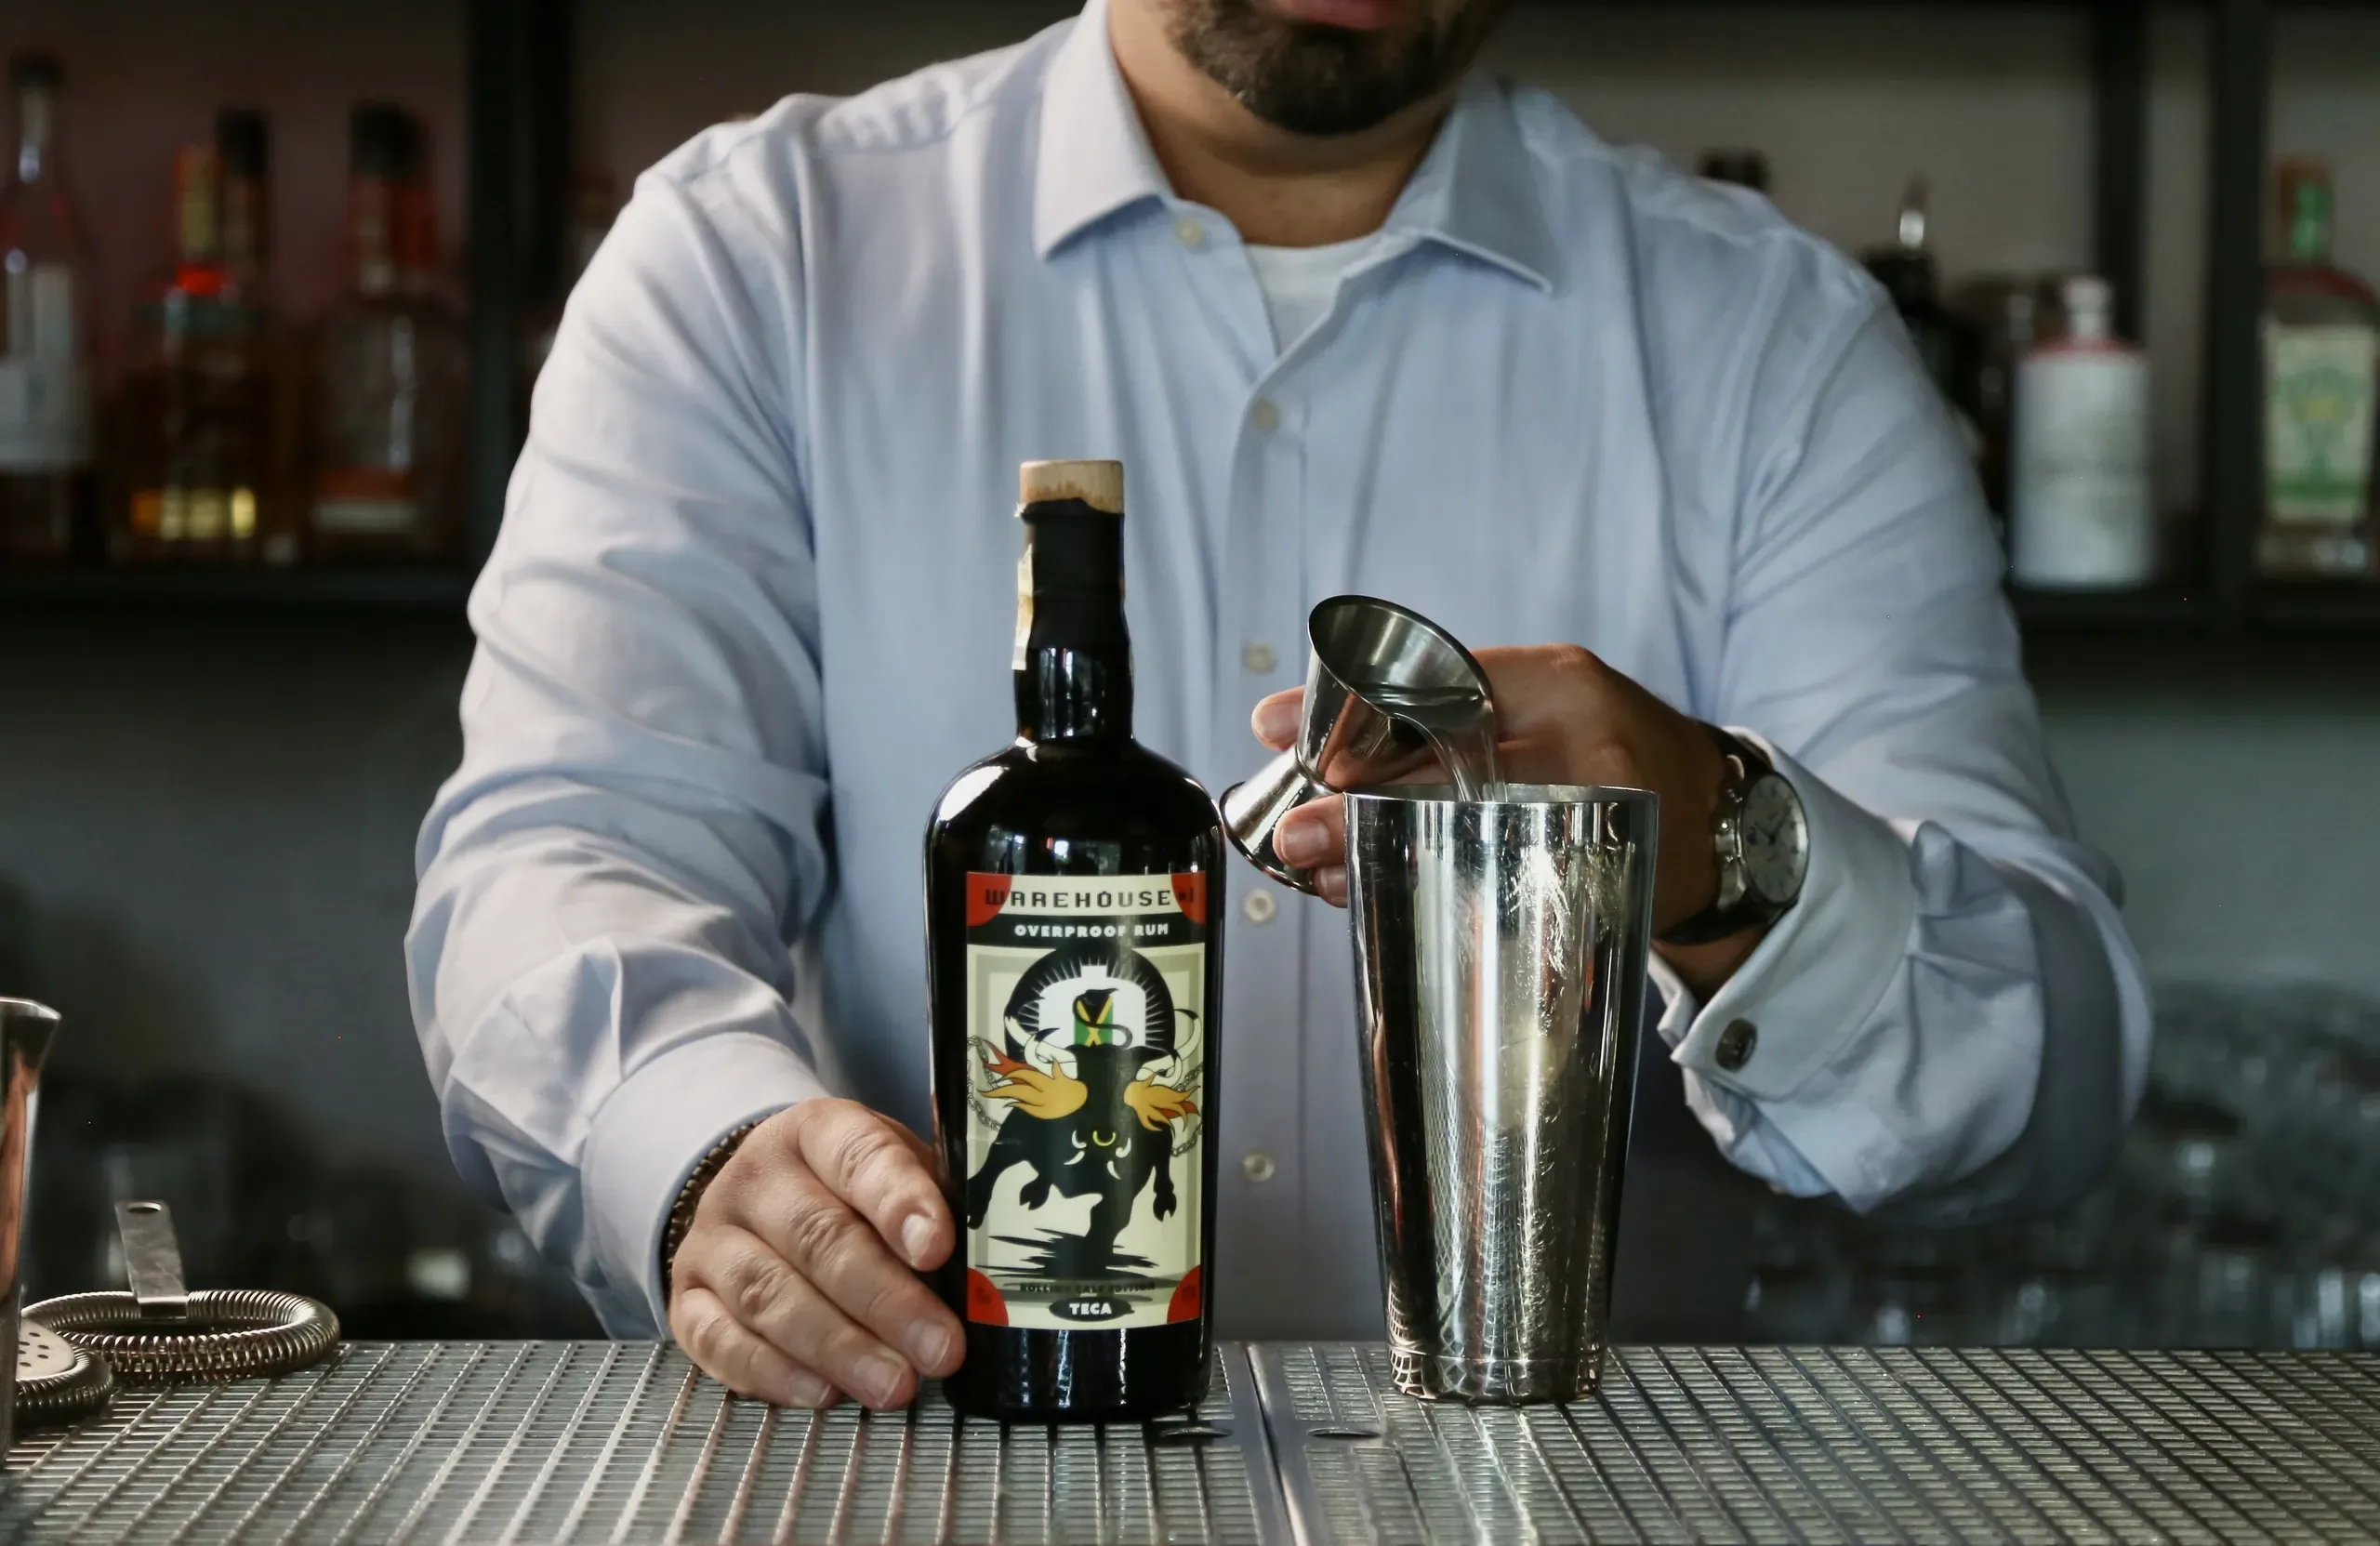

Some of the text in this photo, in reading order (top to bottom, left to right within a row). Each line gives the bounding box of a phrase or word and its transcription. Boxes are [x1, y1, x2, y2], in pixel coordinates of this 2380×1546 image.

[985, 890, 1170, 908] WAREHOUSE
[1014, 923, 1169, 938] OVERPROOF RUM
[1069, 1302, 1112, 1315] TECA
